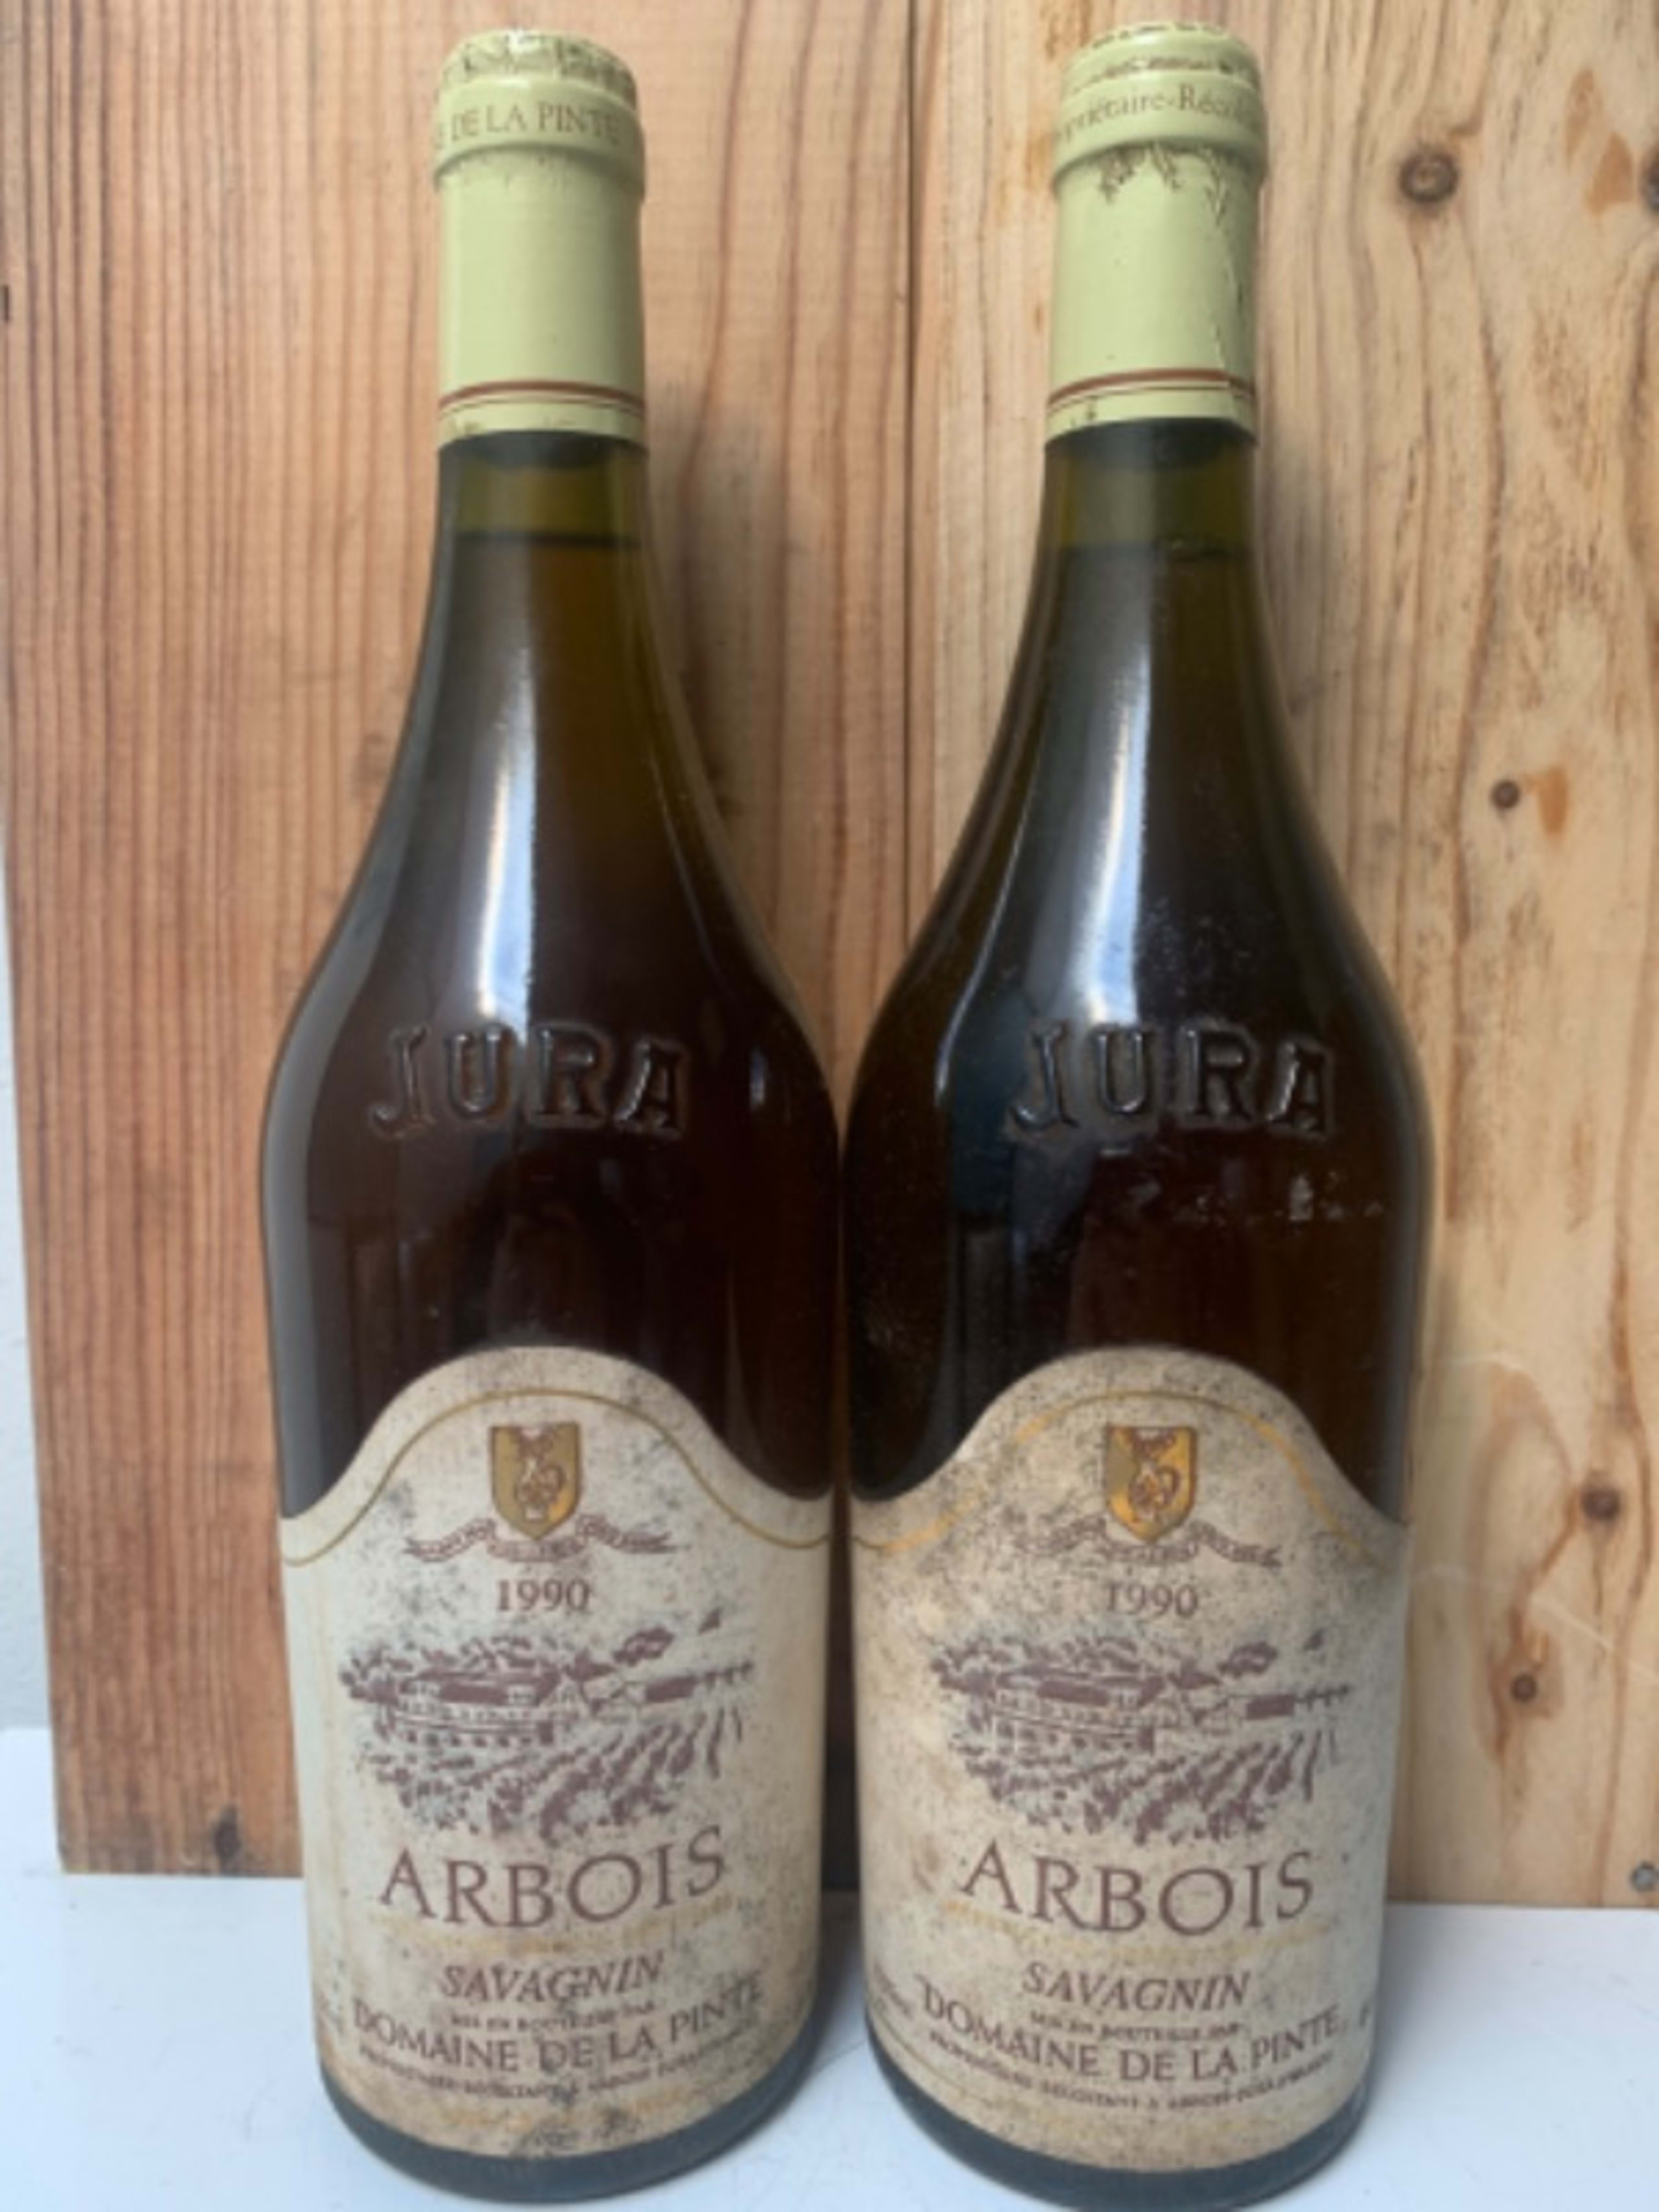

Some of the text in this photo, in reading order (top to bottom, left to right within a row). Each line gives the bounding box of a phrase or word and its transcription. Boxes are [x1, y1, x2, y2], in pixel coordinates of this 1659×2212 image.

[486, 104, 528, 132] LA
[368, 1021, 690, 1141] JURA
[1004, 1019, 1335, 1142] JURA
[496, 1579, 592, 1612] 1990
[1106, 1583, 1199, 1618] 1990
[380, 1824, 727, 1929] ARBOIS
[959, 1839, 1314, 1937] ARBOIS
[353, 1996, 519, 2073] DOMAINE
[540, 2036, 595, 2074] DE
[608, 2023, 656, 2063] LA
[670, 1969, 763, 2044] PINTE
[439, 1950, 666, 2003] SAVAGNIN
[1022, 1961, 1253, 2012] SAVAGNIN
[912, 1970, 1100, 2075] DOMAINE
[1119, 2046, 1177, 2082] DE
[1191, 2047, 1239, 2080] LA
[1251, 2003, 1340, 2071] PINTE
